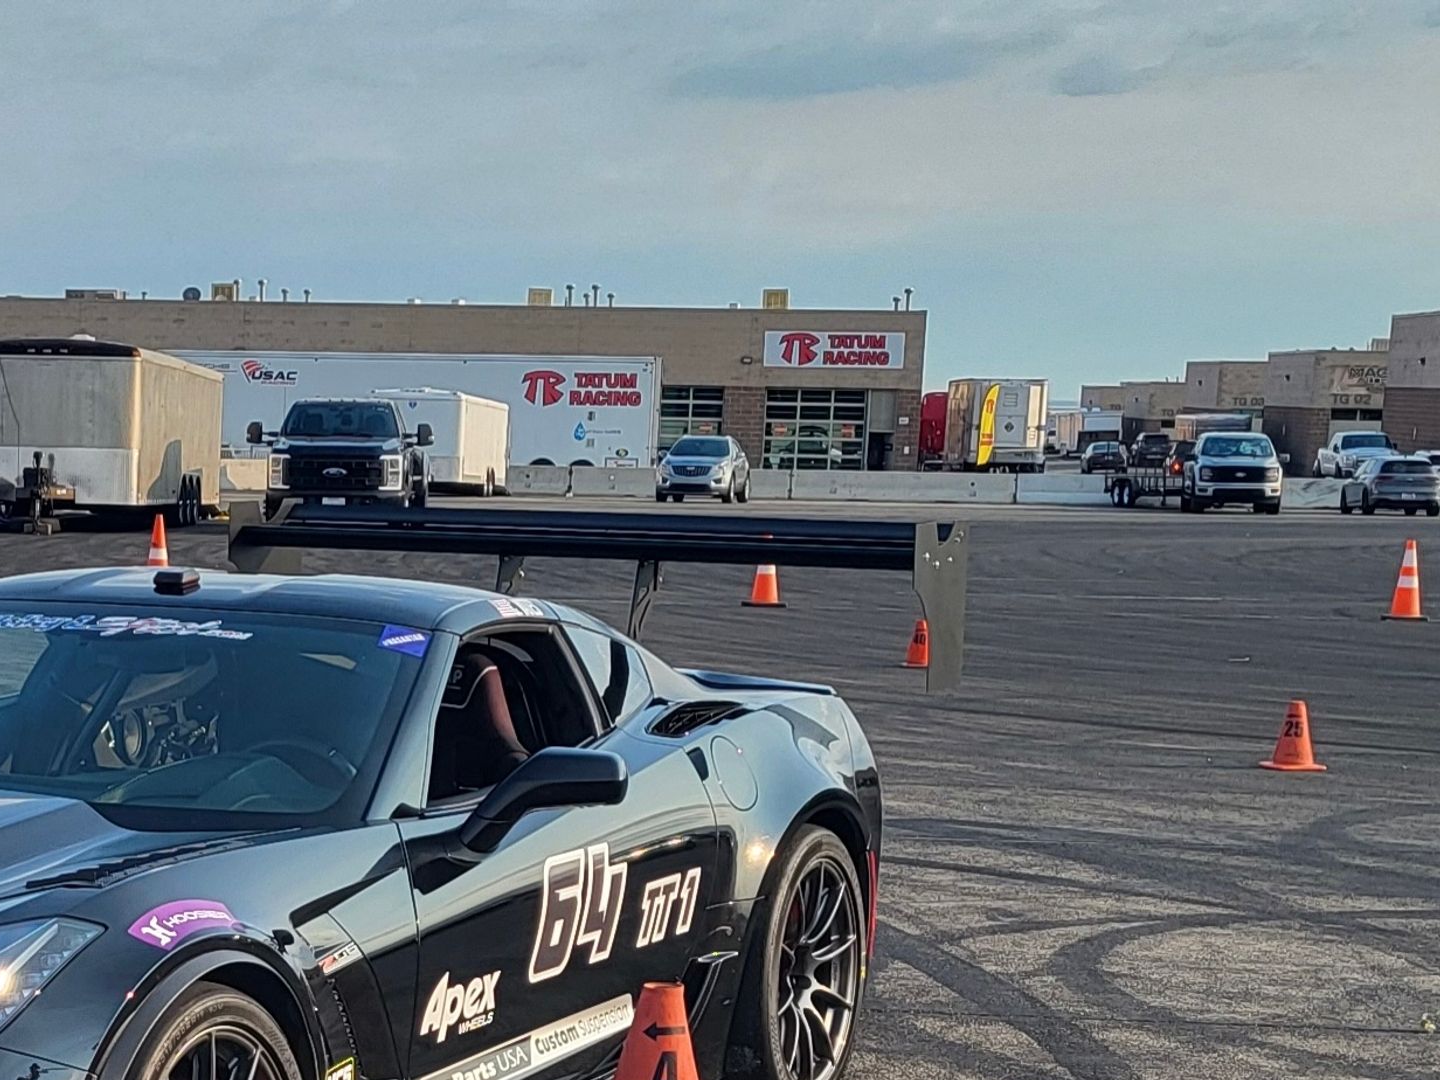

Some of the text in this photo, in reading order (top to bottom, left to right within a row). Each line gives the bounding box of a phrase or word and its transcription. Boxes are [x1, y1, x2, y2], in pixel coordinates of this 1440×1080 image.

[827, 334, 887, 349] TATUM
[822, 351, 890, 366] RACING
[251, 370, 298, 381] USAC
[574, 372, 638, 389] TATUM
[569, 390, 642, 407] RACING
[1330, 394, 1372, 406] TG 02
[1283, 720, 1304, 738] 25
[528, 842, 629, 984] 64
[420, 970, 502, 1043] Apex
[495, 1045, 529, 1072] USA
[534, 1023, 580, 1055] Custom
[577, 1003, 631, 1037] Suspension
